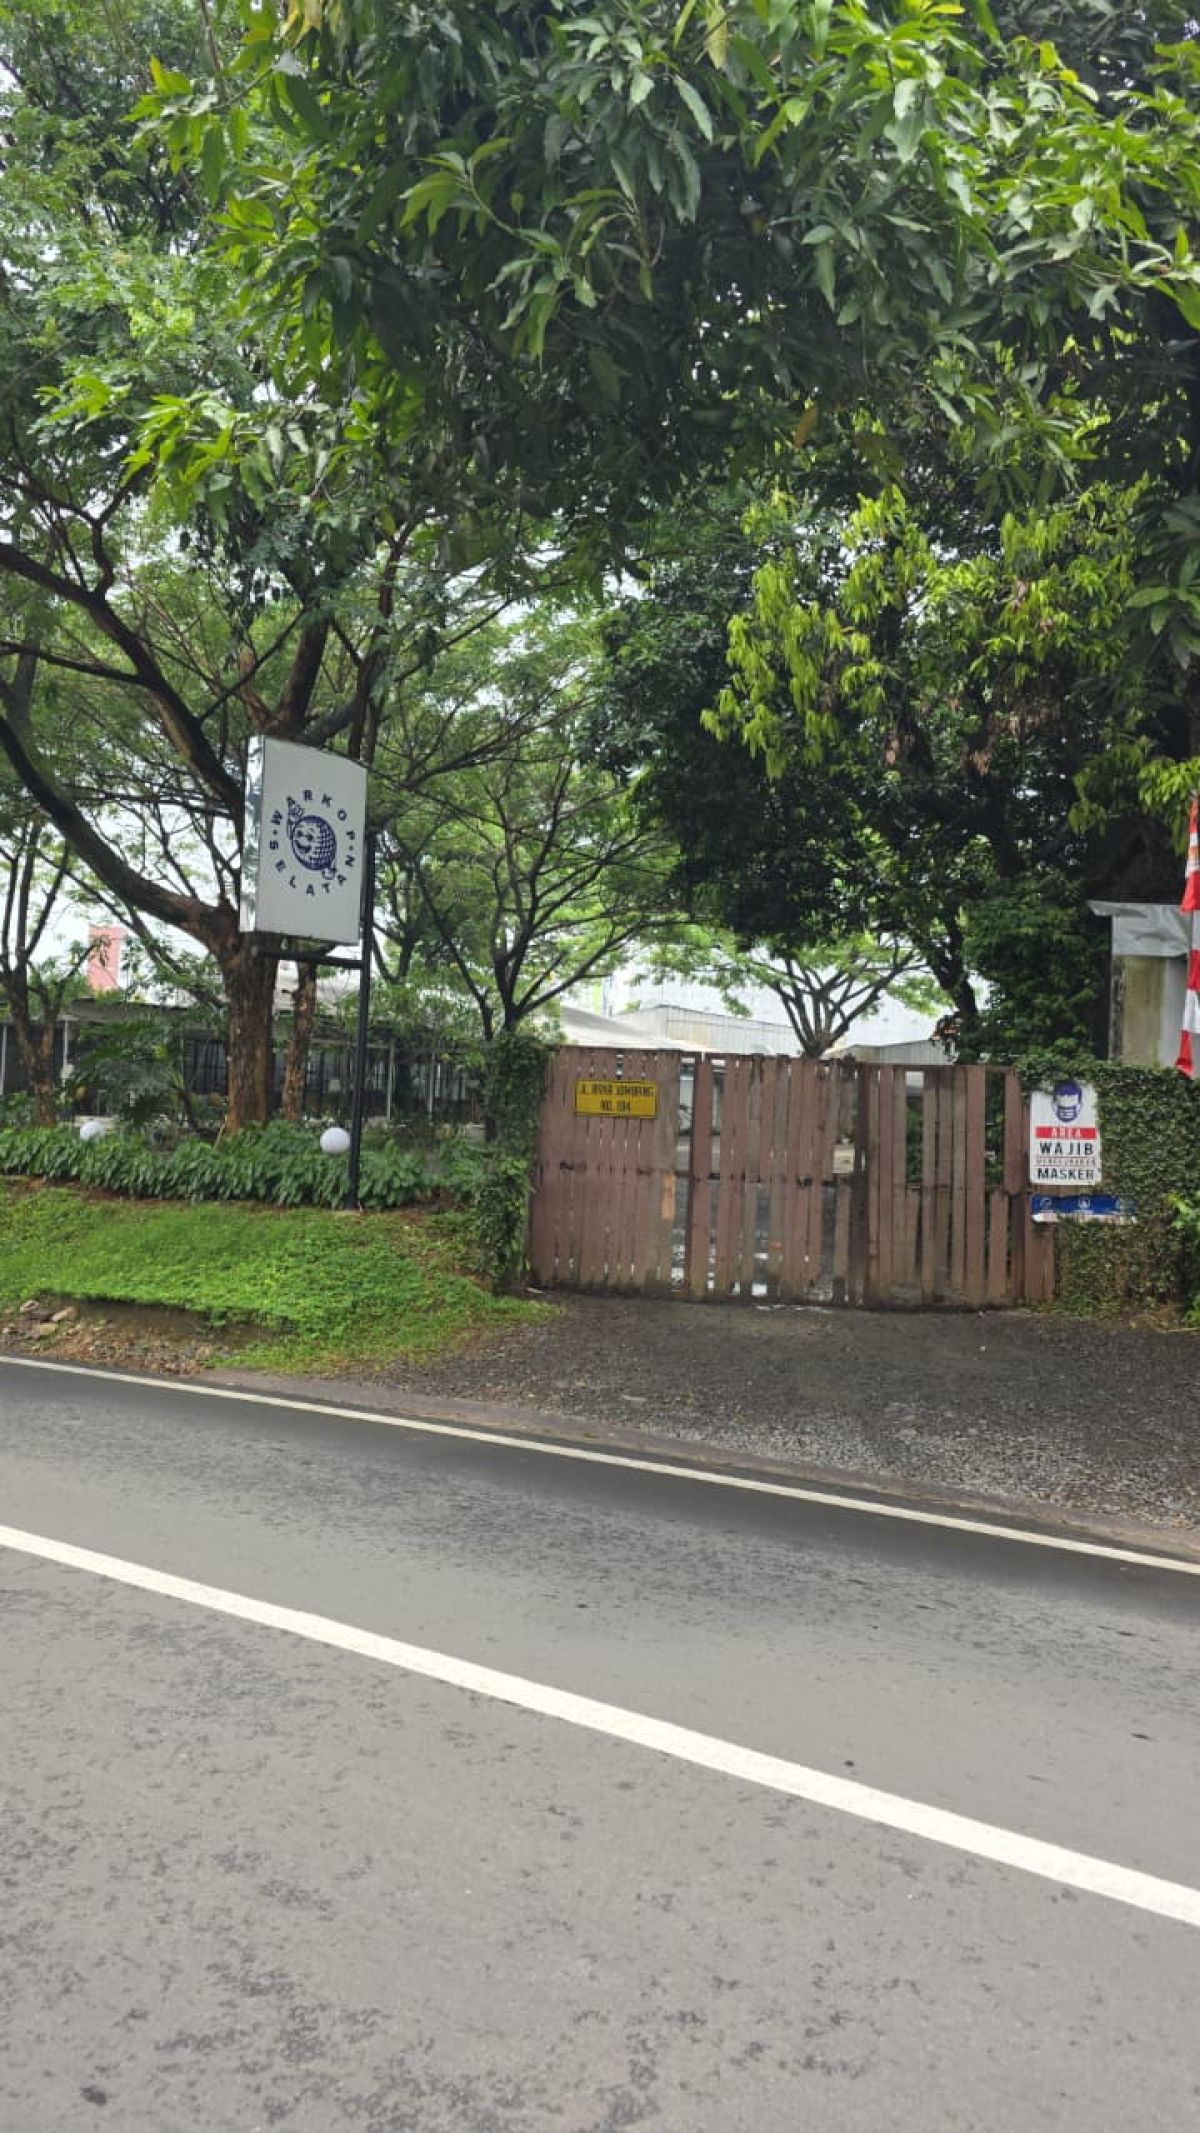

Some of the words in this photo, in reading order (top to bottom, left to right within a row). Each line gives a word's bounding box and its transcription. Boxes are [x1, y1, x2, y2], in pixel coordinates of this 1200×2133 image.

[271, 789, 356, 840] WARKOP
[269, 840, 356, 897] SELATAN
[1051, 1128, 1082, 1139] AREA
[1039, 1141, 1094, 1156] WAJIB
[1037, 1167, 1094, 1180] MASKER
